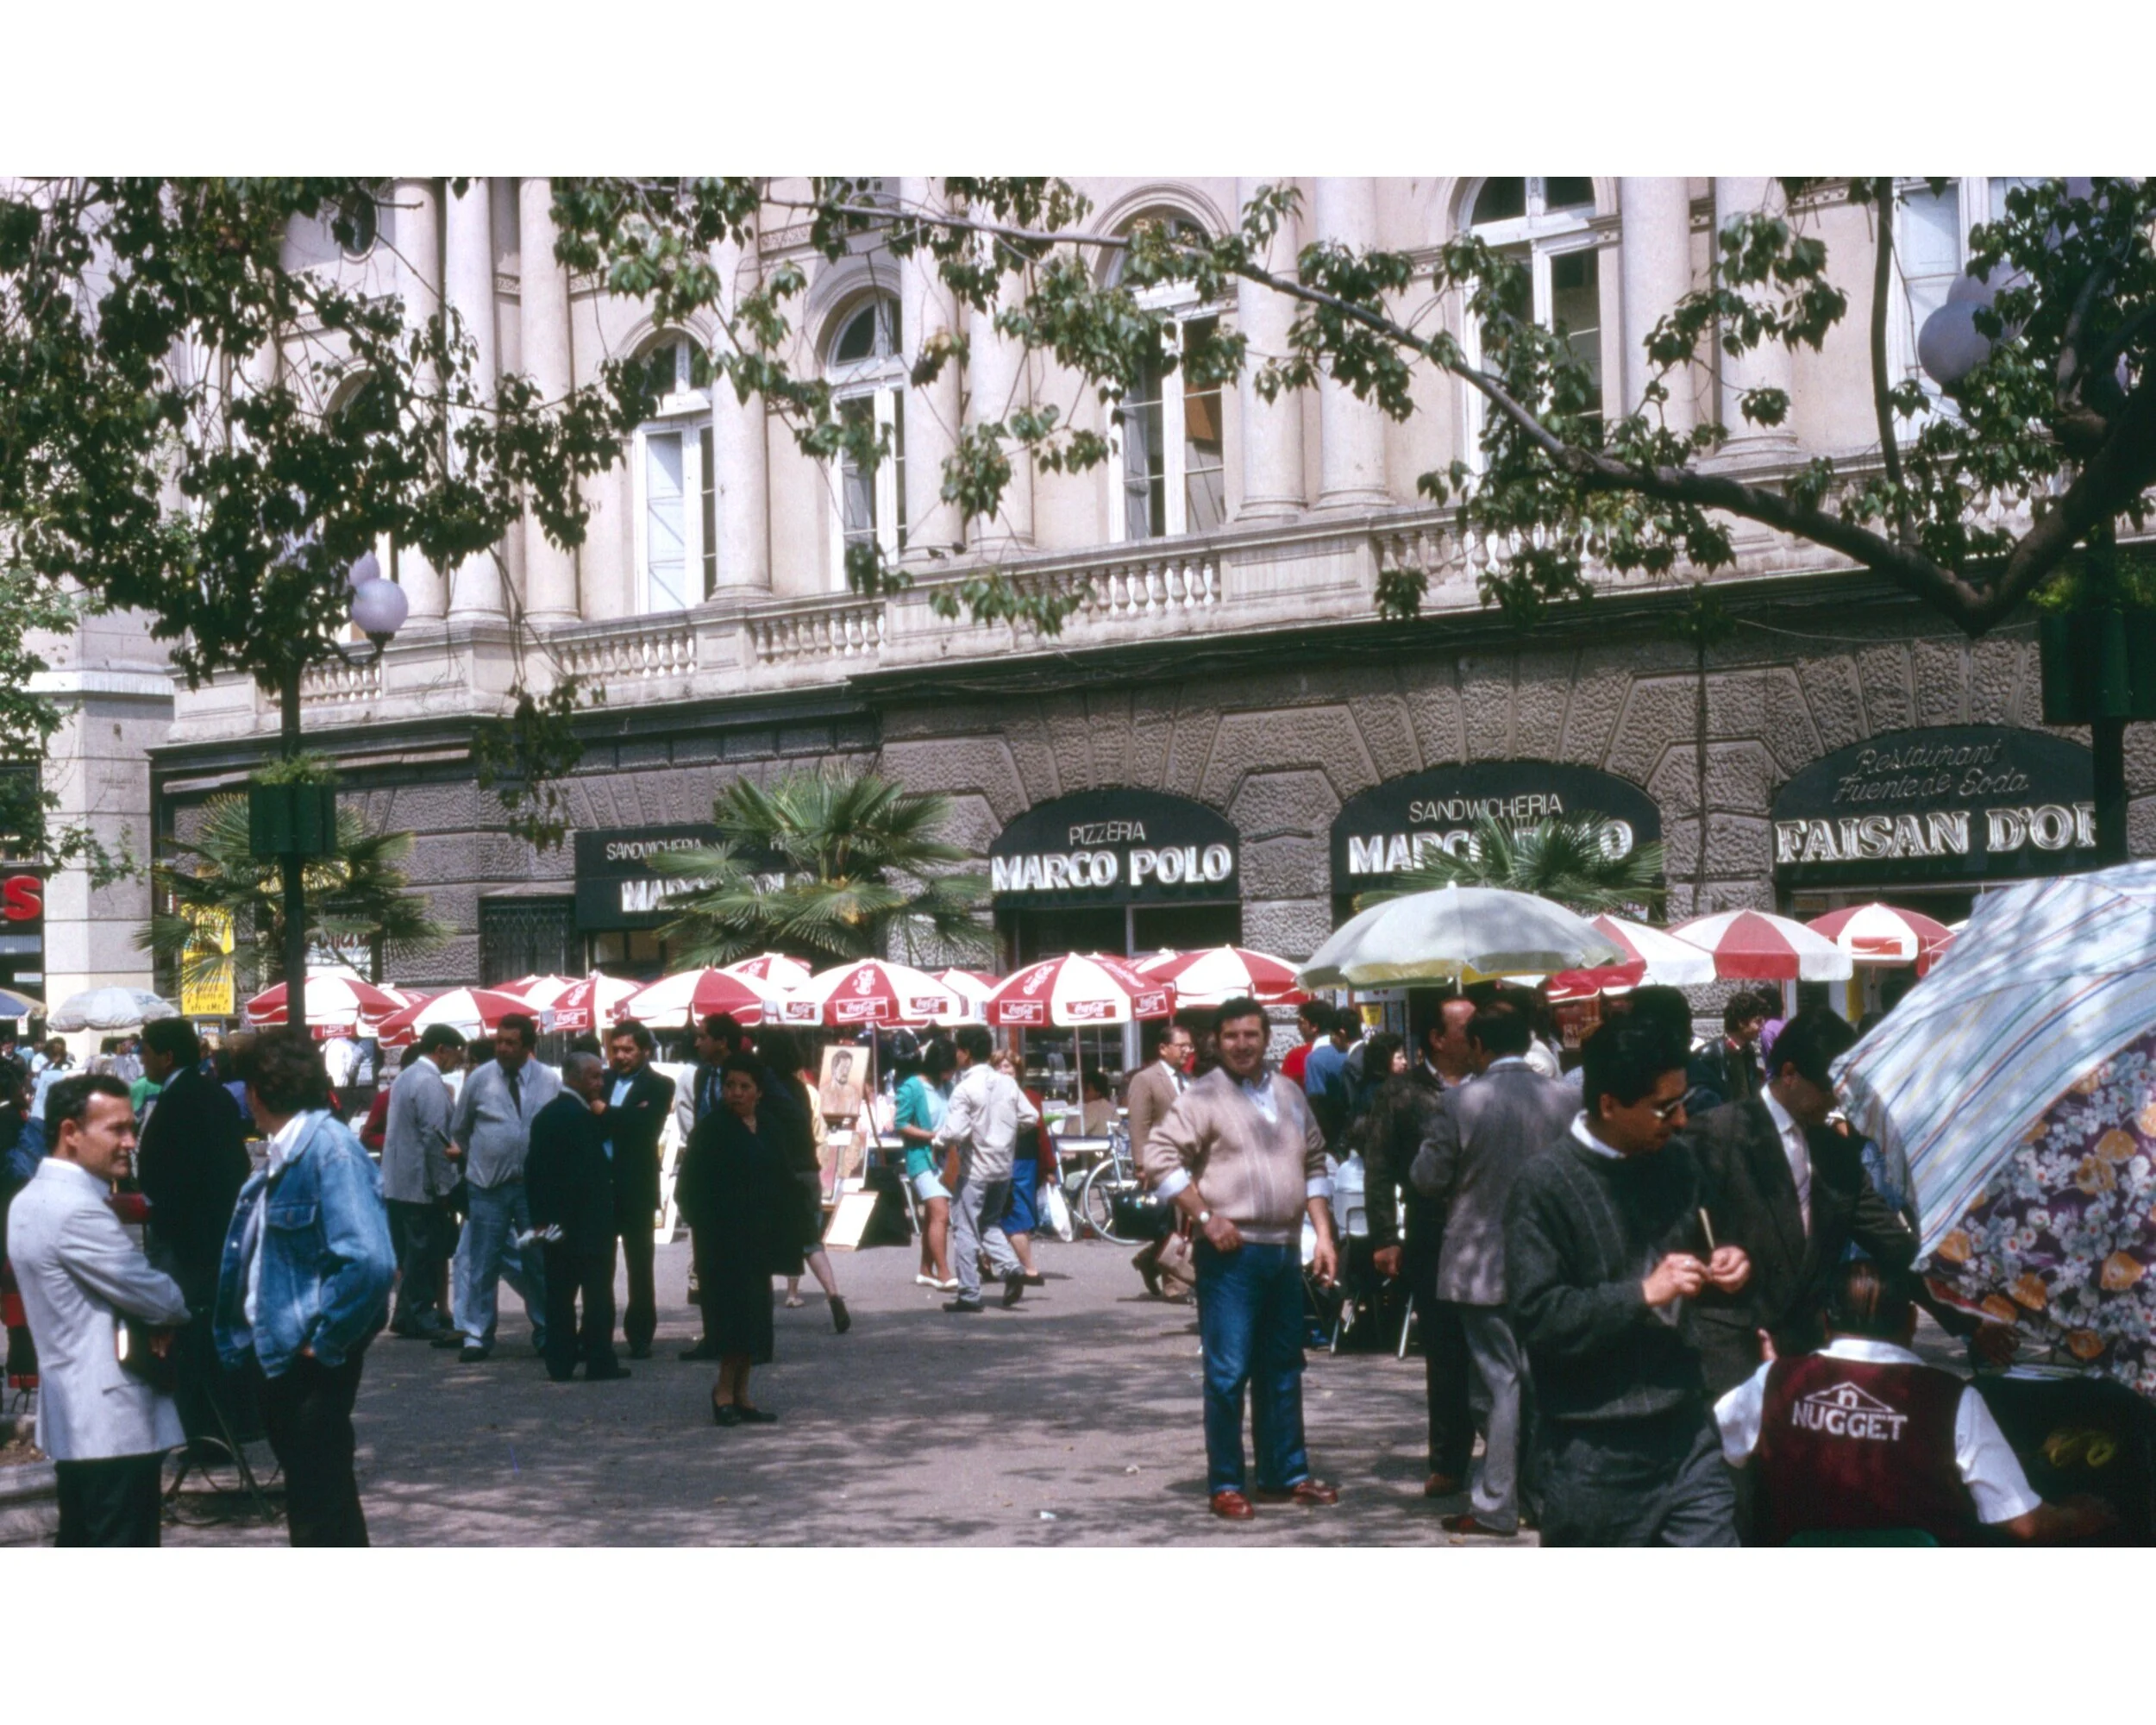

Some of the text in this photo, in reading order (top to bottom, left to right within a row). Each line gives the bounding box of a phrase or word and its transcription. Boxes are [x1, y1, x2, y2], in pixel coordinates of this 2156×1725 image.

[1854, 739, 2002, 775] Restaurant
[1833, 767, 2029, 803] Fuente de Soda
[1409, 793, 1563, 823] SANDWICHERIA
[1069, 820, 1147, 845] PIZZERIA
[1775, 811, 1971, 862] FAISAN
[991, 843, 1232, 891] MARCO POLO
[1792, 1400, 1908, 1441] NUGGET
